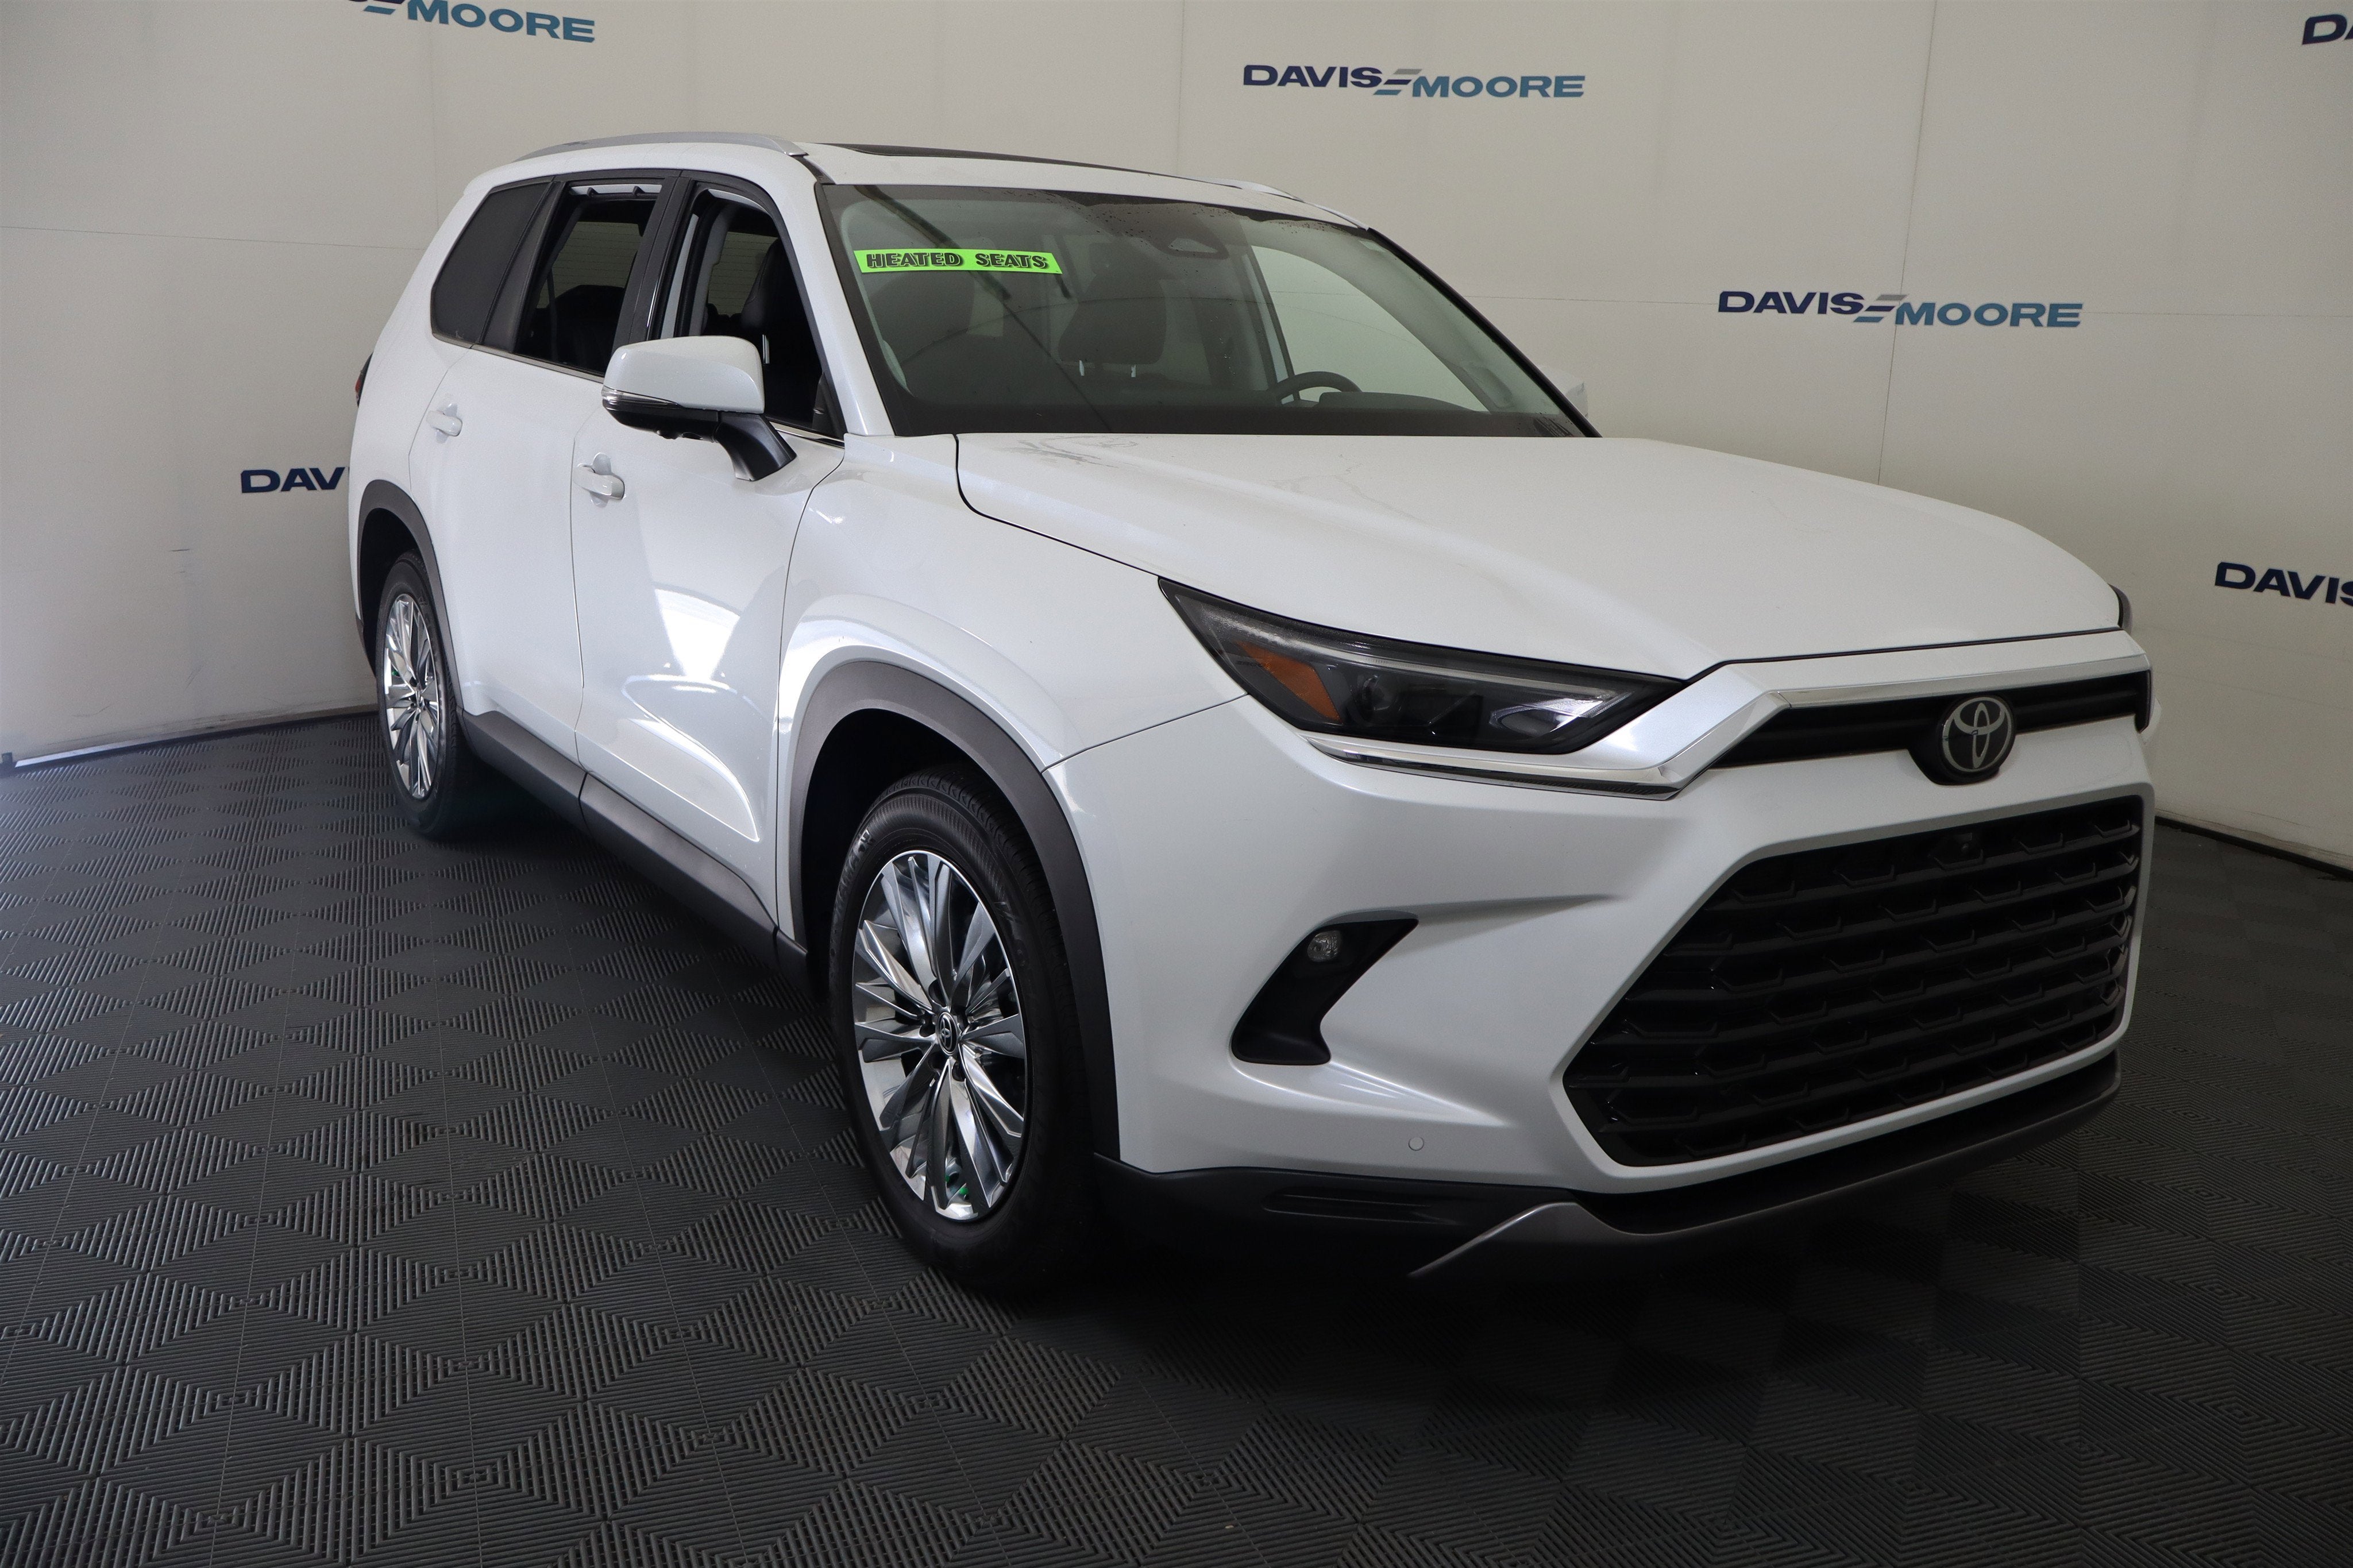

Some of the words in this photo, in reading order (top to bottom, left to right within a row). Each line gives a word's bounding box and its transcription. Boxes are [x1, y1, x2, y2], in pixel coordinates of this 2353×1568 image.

[407, 0, 595, 43] MOORE
[2302, 13, 2353, 45] D
[1243, 64, 1383, 88] DAVIS
[1412, 75, 1586, 98] MOORE
[866, 252, 963, 268] HEATED
[975, 253, 1049, 269] SEATS
[1718, 291, 1865, 315] DAVIS
[1895, 302, 2083, 328] MOORE
[240, 466, 349, 493] DAV
